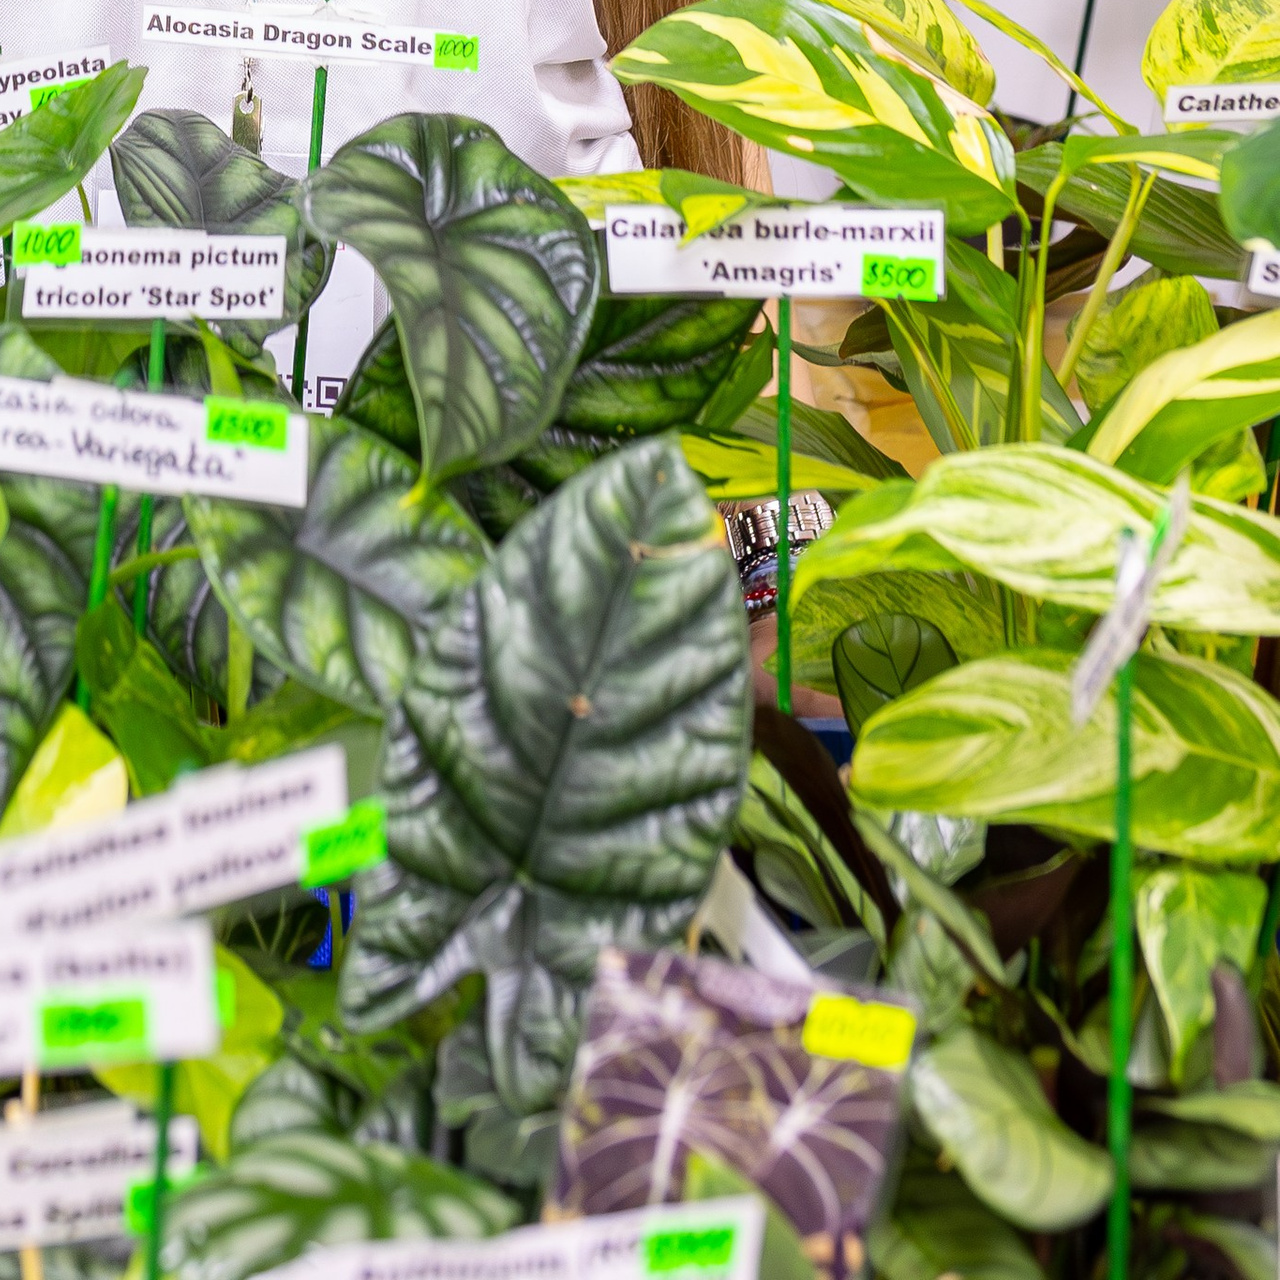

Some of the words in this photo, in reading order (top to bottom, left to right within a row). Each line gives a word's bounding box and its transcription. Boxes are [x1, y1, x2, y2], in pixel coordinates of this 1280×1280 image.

[147, 13, 255, 41] Alocasia
[262, 23, 353, 52] Dragon
[360, 32, 433, 56] Scale
[437, 39, 477, 60] 1000
[20, 228, 75, 256] 1000
[754, 217, 936, 242] burle-marxii
[191, 244, 279, 270] pictum
[702, 261, 843, 287] 'Amagris'
[36, 285, 133, 308] tricolor
[141, 286, 201, 308] 'Star
[209, 286, 276, 312] Spot'
